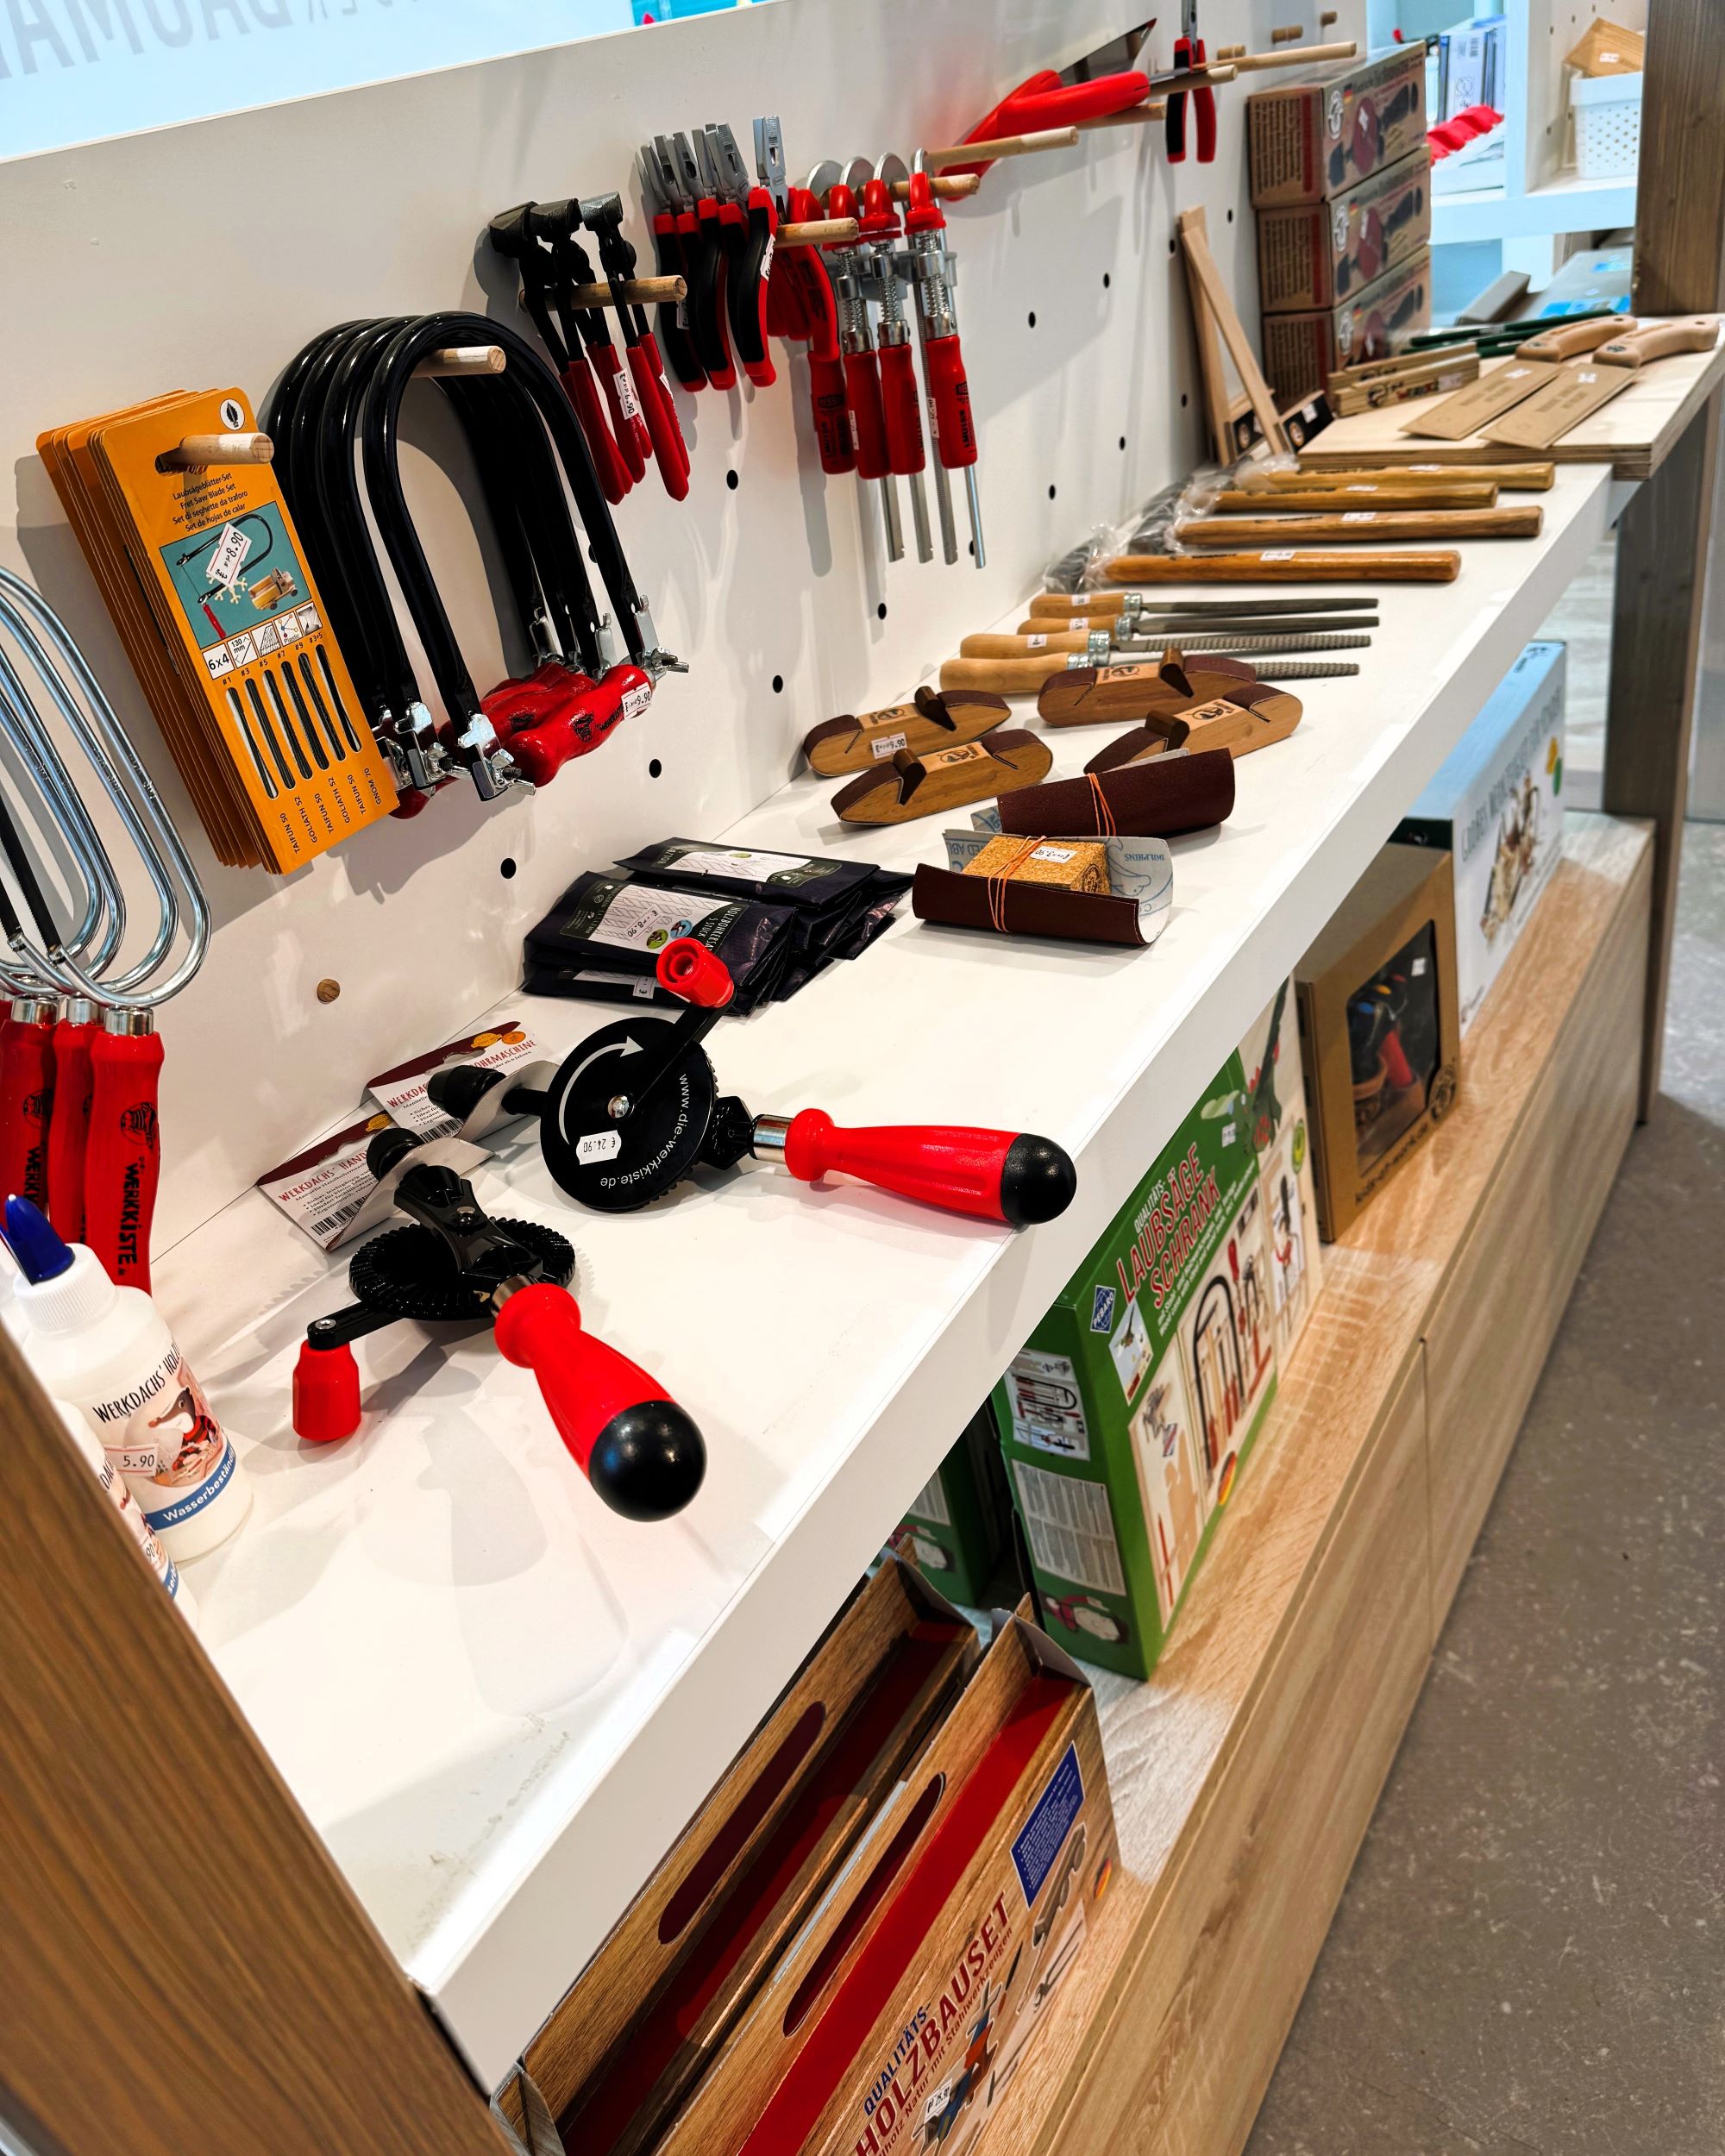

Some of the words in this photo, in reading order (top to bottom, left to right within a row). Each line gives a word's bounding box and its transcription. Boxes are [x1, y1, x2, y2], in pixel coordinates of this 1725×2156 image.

[172, 473, 232, 500] Laubsägeblätter-Set
[179, 499, 194, 510] Fret
[194, 496, 207, 505] Saw
[208, 489, 225, 498] Blade
[226, 483, 236, 492] Set
[172, 516, 185, 525] Set
[192, 502, 219, 517] seghette
[220, 498, 228, 506] da
[228, 491, 248, 504] traforo
[185, 523, 197, 532] Set
[207, 512, 223, 523] hojas
[232, 504, 246, 513] calar
[227, 531, 244, 557] 8.90
[231, 638, 242, 647] 130
[283, 635, 300, 643] Plastic
[208, 653, 229, 671] 6x4
[277, 650, 285, 659] #7
[241, 668, 250, 677] #3
[328, 777, 336, 787] 52
[348, 774, 354, 784] 50
[363, 768, 370, 777] 70
[295, 795, 301, 805] 52
[314, 793, 321, 802] 50
[352, 785, 367, 815] TAIFUN
[368, 779, 381, 805] GNOM
[279, 812, 286, 823] 50
[318, 803, 334, 834] TAIFUN
[333, 788, 350, 824] GOLIATH
[300, 807, 317, 843] GOLIATH
[285, 824, 301, 854] TAIFUN
[1124, 853, 1164, 862] DOLPHINS
[628, 920, 645, 937] 8.90
[473, 1039, 537, 1069] OHRMASCHINE
[599, 1074, 690, 1189] www.die-werkkiste.de
[584, 1138, 607, 1153] 24.90
[1133, 1179, 1166, 1234] QUALITÄTS-
[1116, 1141, 1203, 1304] LAUBSÄGE
[1150, 1164, 1220, 1309] SCHRANK
[1093, 1291, 1114, 1328] PEBARO
[122, 1454, 155, 1469] 5.90
[855, 1890, 1011, 2156] HOLZBAUSET
[905, 2077, 930, 2119] Natur
[931, 2050, 945, 2075] mit
[945, 1927, 1013, 2047] Stahlwerkzeugen
[863, 2002, 932, 2116] QUALITÄTS-
